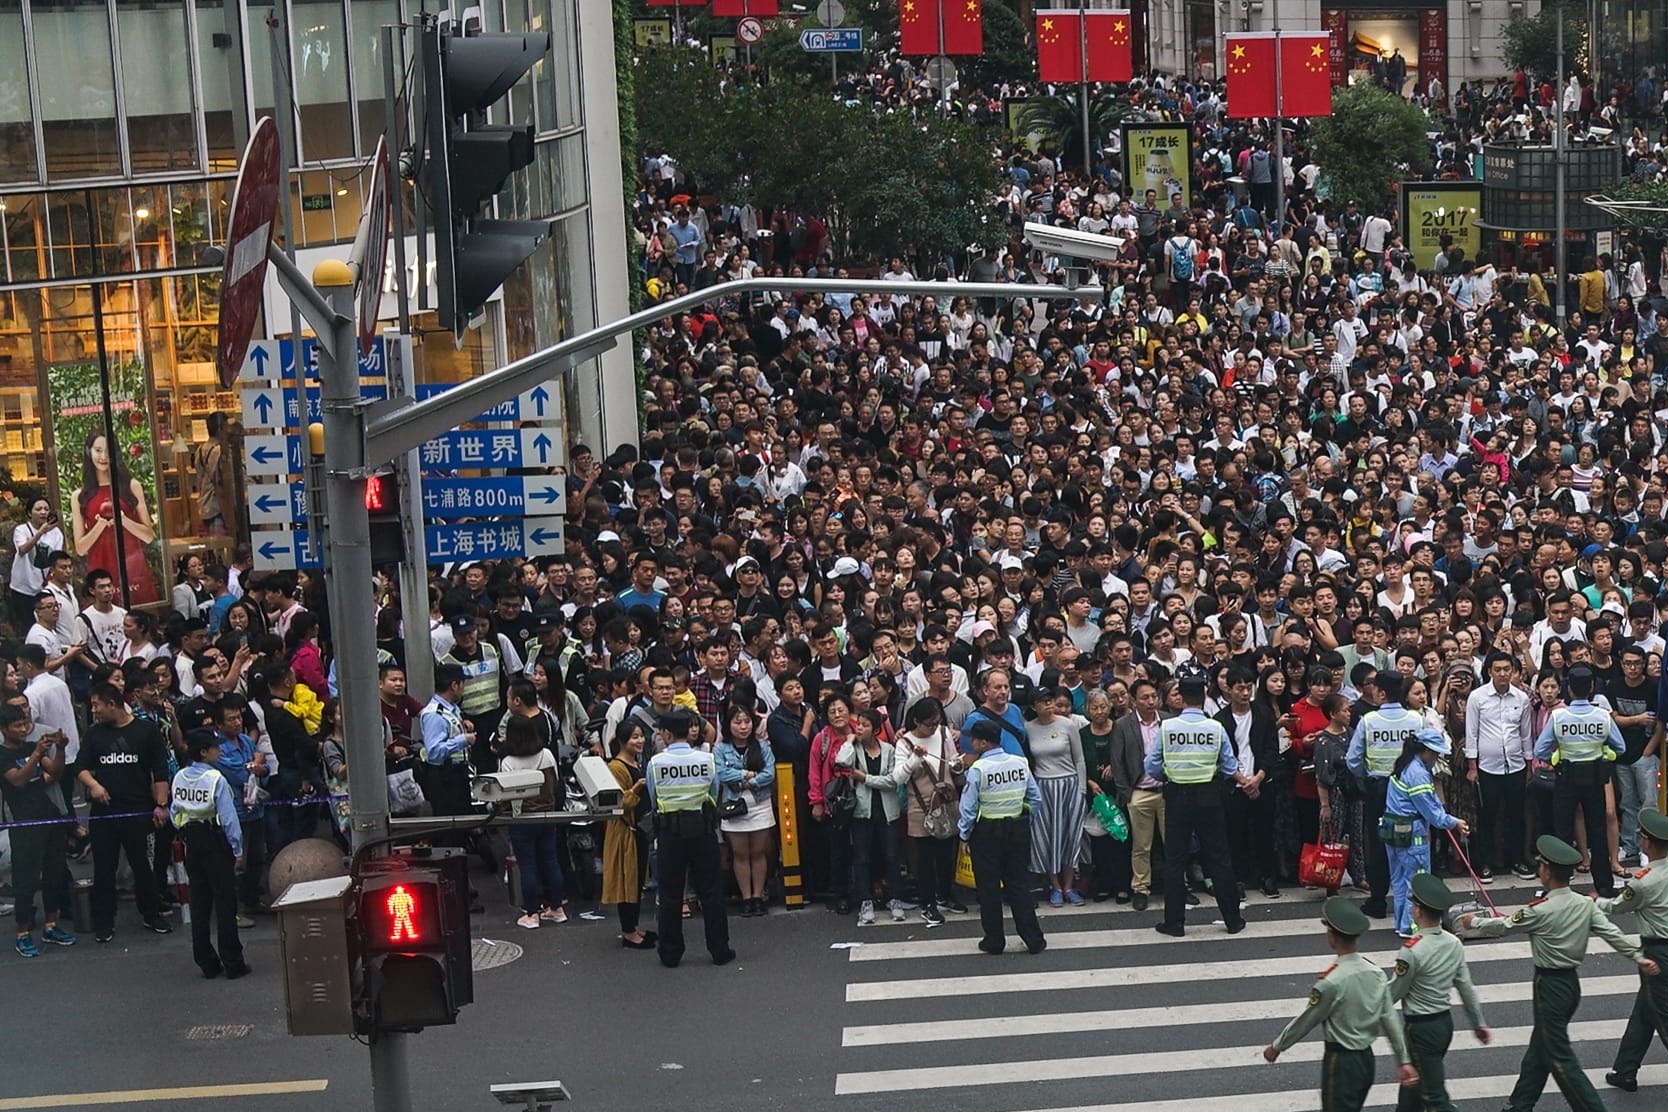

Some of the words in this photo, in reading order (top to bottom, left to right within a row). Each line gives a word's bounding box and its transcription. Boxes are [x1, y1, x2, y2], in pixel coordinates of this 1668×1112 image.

[1138, 136, 1179, 148] 17成长
[1421, 210, 1468, 227] 2017
[1421, 227, 1468, 237] 和你在一起
[423, 434, 517, 464] 新世界
[429, 526, 521, 556] 上海书城
[1561, 723, 1603, 736] POLICE
[1169, 733, 1214, 745] POLICE
[100, 753, 138, 764] adidas
[660, 764, 709, 779] POLICE
[987, 769, 1026, 787] POLICE
[175, 786, 209, 802] POLICE
